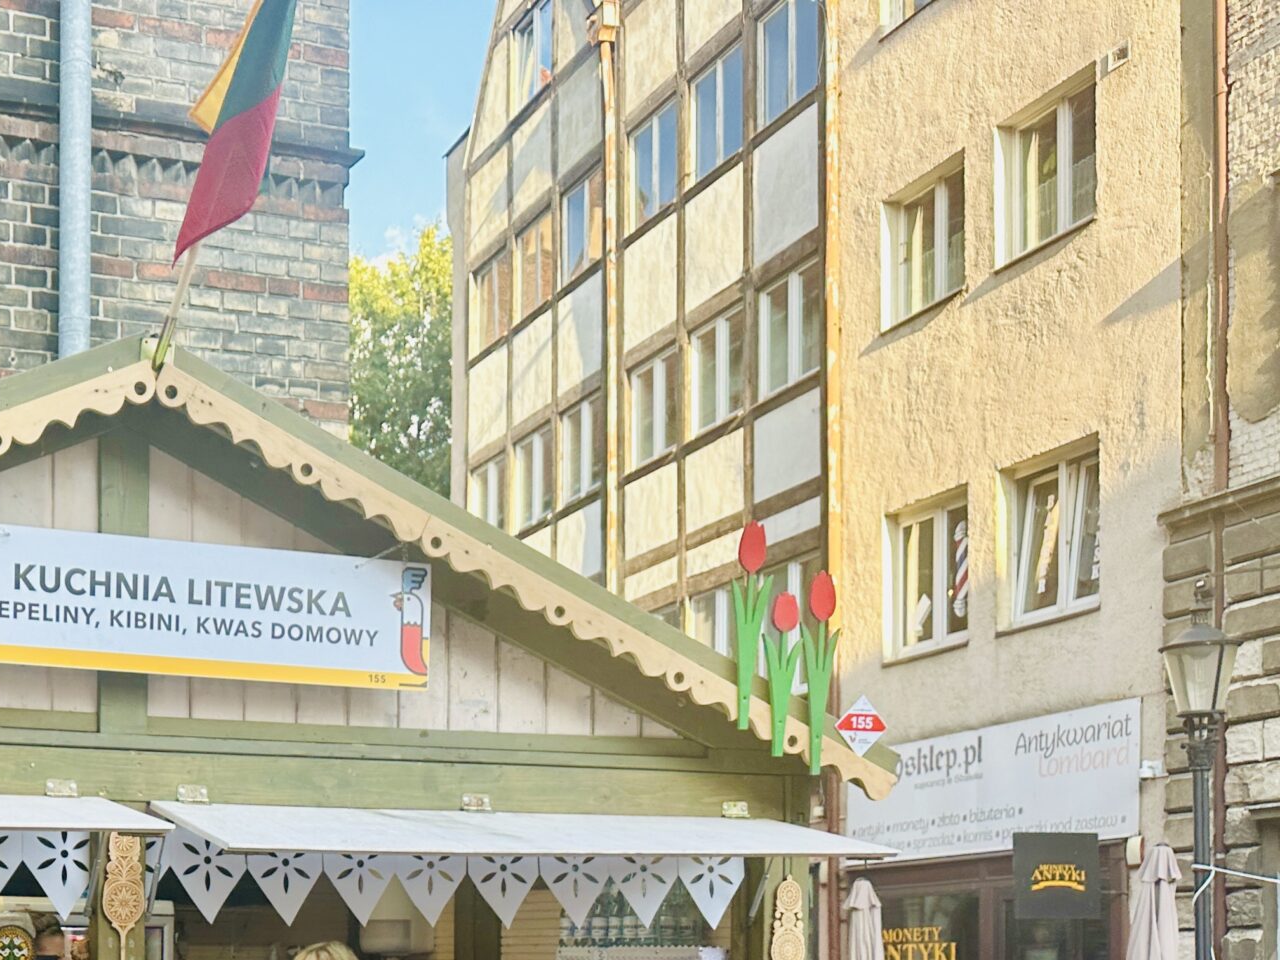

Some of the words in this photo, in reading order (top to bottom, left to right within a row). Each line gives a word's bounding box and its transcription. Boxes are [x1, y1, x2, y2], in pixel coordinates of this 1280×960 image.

[13, 562, 177, 604] KUCHNIA
[187, 578, 353, 618] LITEWSKA
[109, 609, 188, 636] KIBINI,
[196, 615, 263, 639] KWAS
[270, 622, 379, 647] DOMOWY
[368, 673, 387, 684] 155
[850, 715, 874, 730] 155
[1014, 713, 1133, 759] Antykwariat
[1037, 740, 1131, 779] Lombard
[1031, 868, 1086, 881] ANTYKI
[882, 926, 942, 943] MONETY
